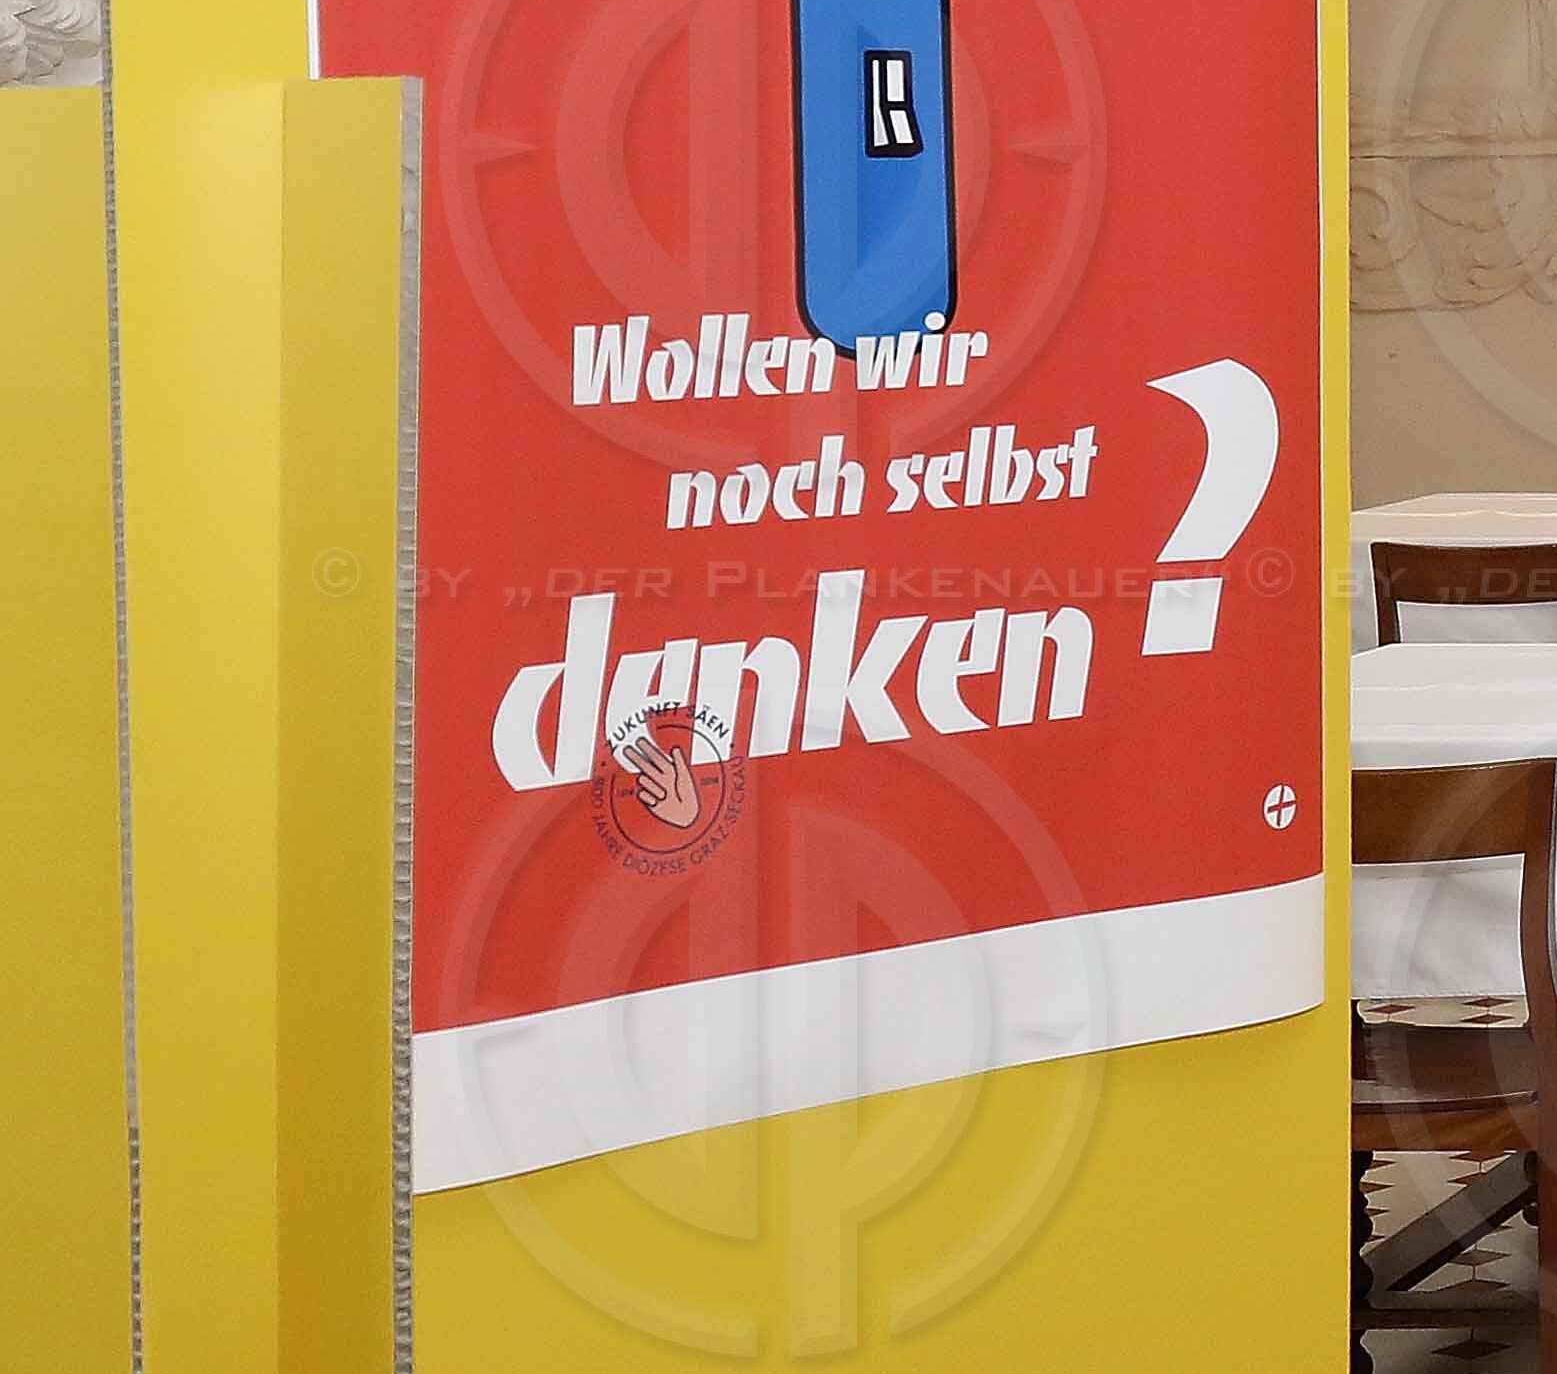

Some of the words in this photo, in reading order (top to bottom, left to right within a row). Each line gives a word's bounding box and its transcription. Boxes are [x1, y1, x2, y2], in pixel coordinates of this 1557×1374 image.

[573, 313, 836, 406] Wollen
[855, 311, 988, 392] wir
[665, 435, 868, 531] noch
[887, 424, 1099, 514] selbst
[491, 569, 1096, 793] denken
[608, 701, 682, 753] ZUKUNFT
[686, 703, 730, 739] SÄEN
